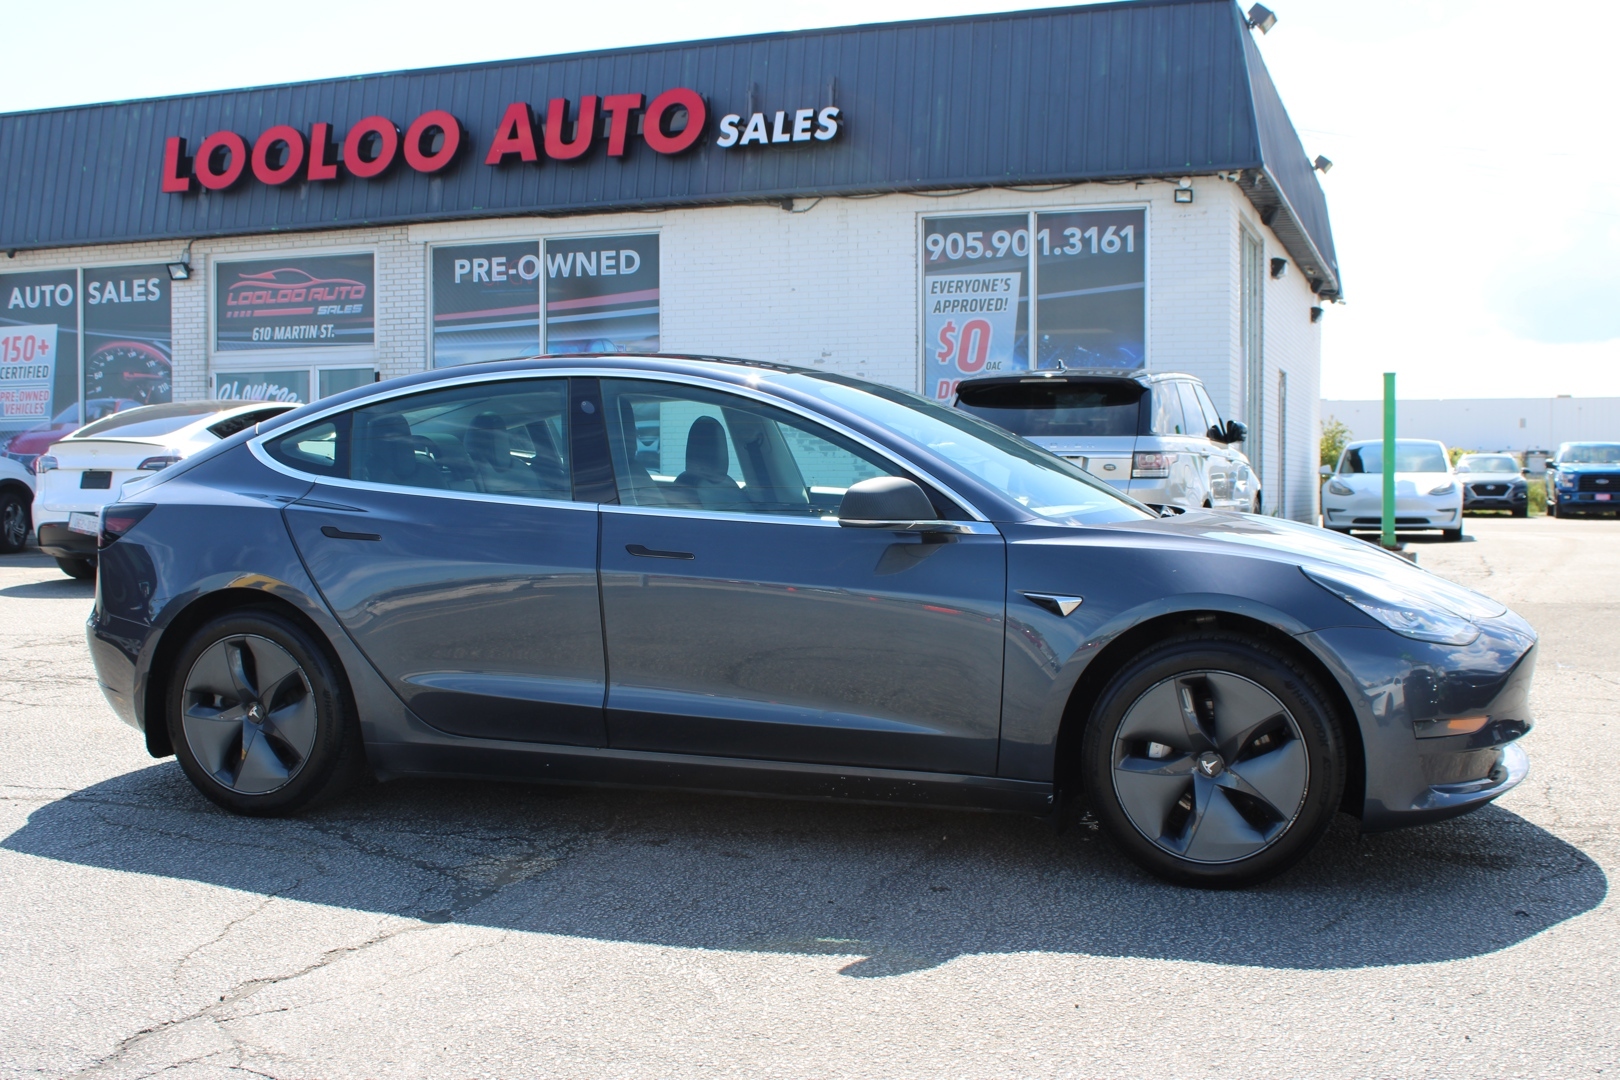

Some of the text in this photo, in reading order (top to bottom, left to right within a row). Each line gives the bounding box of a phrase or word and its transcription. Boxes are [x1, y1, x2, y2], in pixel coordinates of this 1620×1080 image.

[162, 87, 840, 193] LOOLOO AUTO SALES
[925, 225, 1135, 261] 905.901.3161
[454, 249, 641, 283] PRE-OWNED
[8, 277, 161, 310] AUTO SALES
[930, 277, 1011, 295] EVERYONE'S
[226, 286, 366, 306] LOOLOO AUTO
[933, 297, 1008, 314] APPROVED!
[317, 304, 363, 315] SALES
[252, 324, 335, 341] 610 MARTIN ST.
[1, 334, 49, 363] 150+
[937, 319, 1002, 372] $0 OAC
[0, 365, 49, 379] CERTIFIED
[0, 390, 49, 402] PRE-OWNED
[4, 402, 44, 415] VEHICLES
